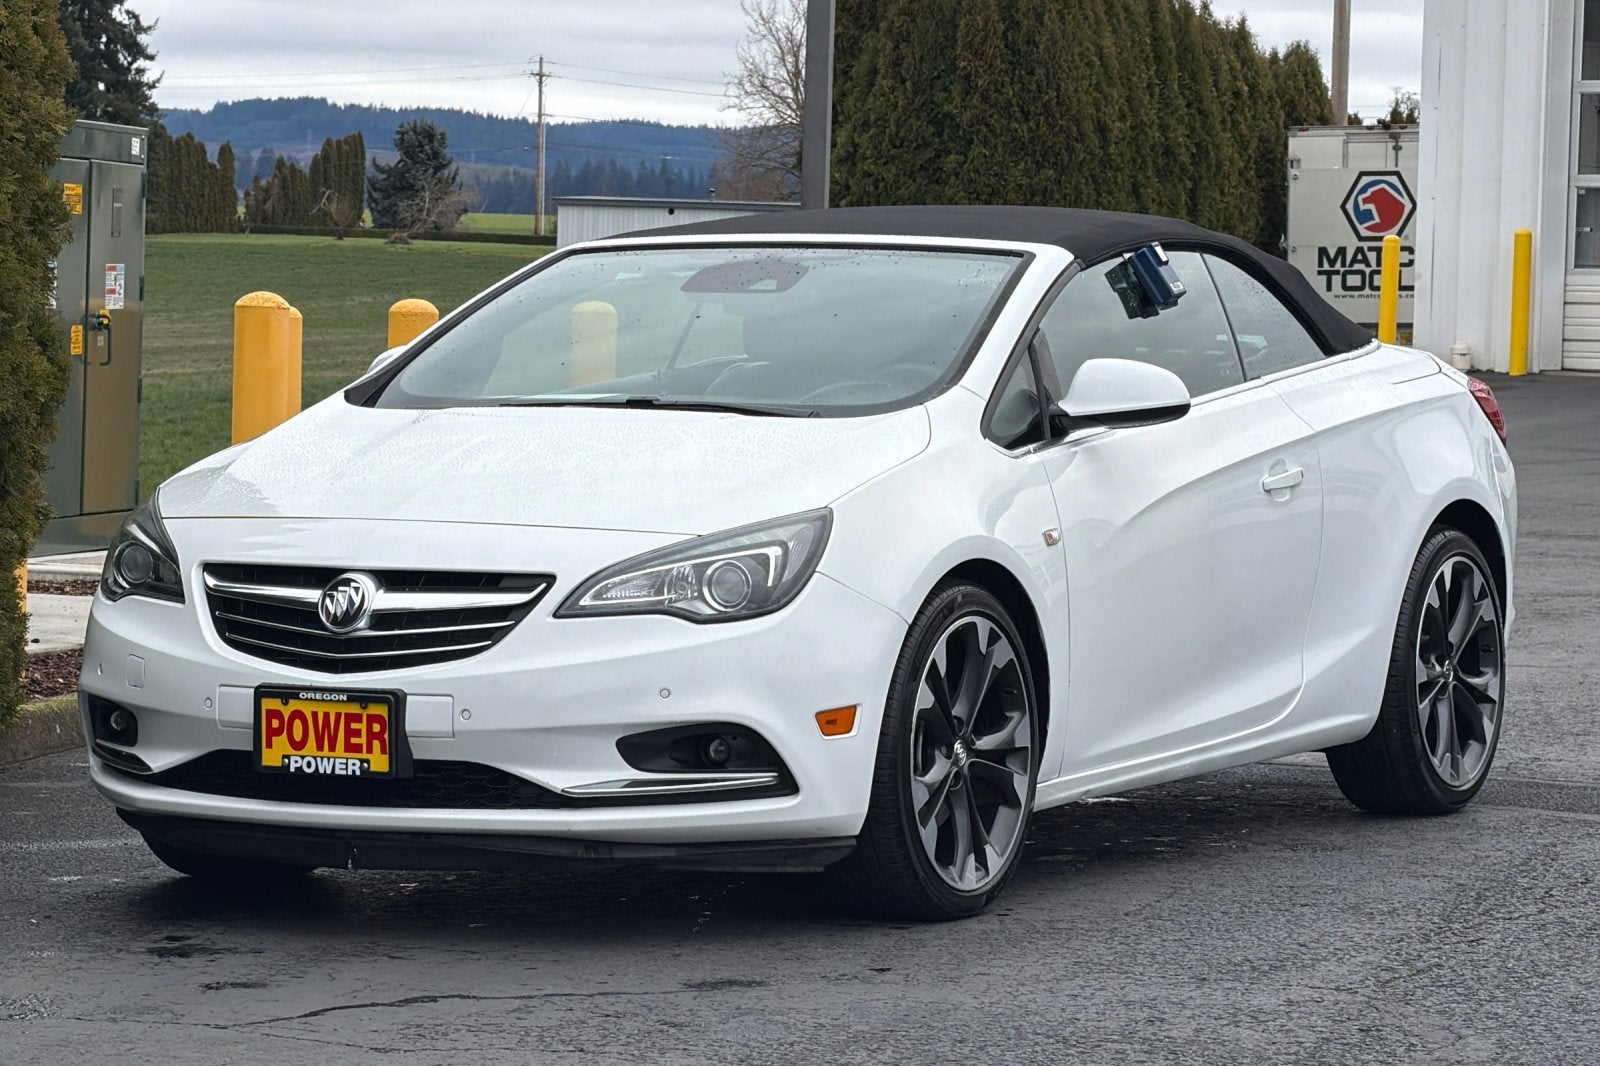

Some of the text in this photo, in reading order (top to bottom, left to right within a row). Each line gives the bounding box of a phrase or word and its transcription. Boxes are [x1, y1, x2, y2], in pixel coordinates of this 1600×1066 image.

[299, 692, 347, 701] OREGON
[265, 708, 388, 755] POWER
[289, 755, 361, 776] POWER
